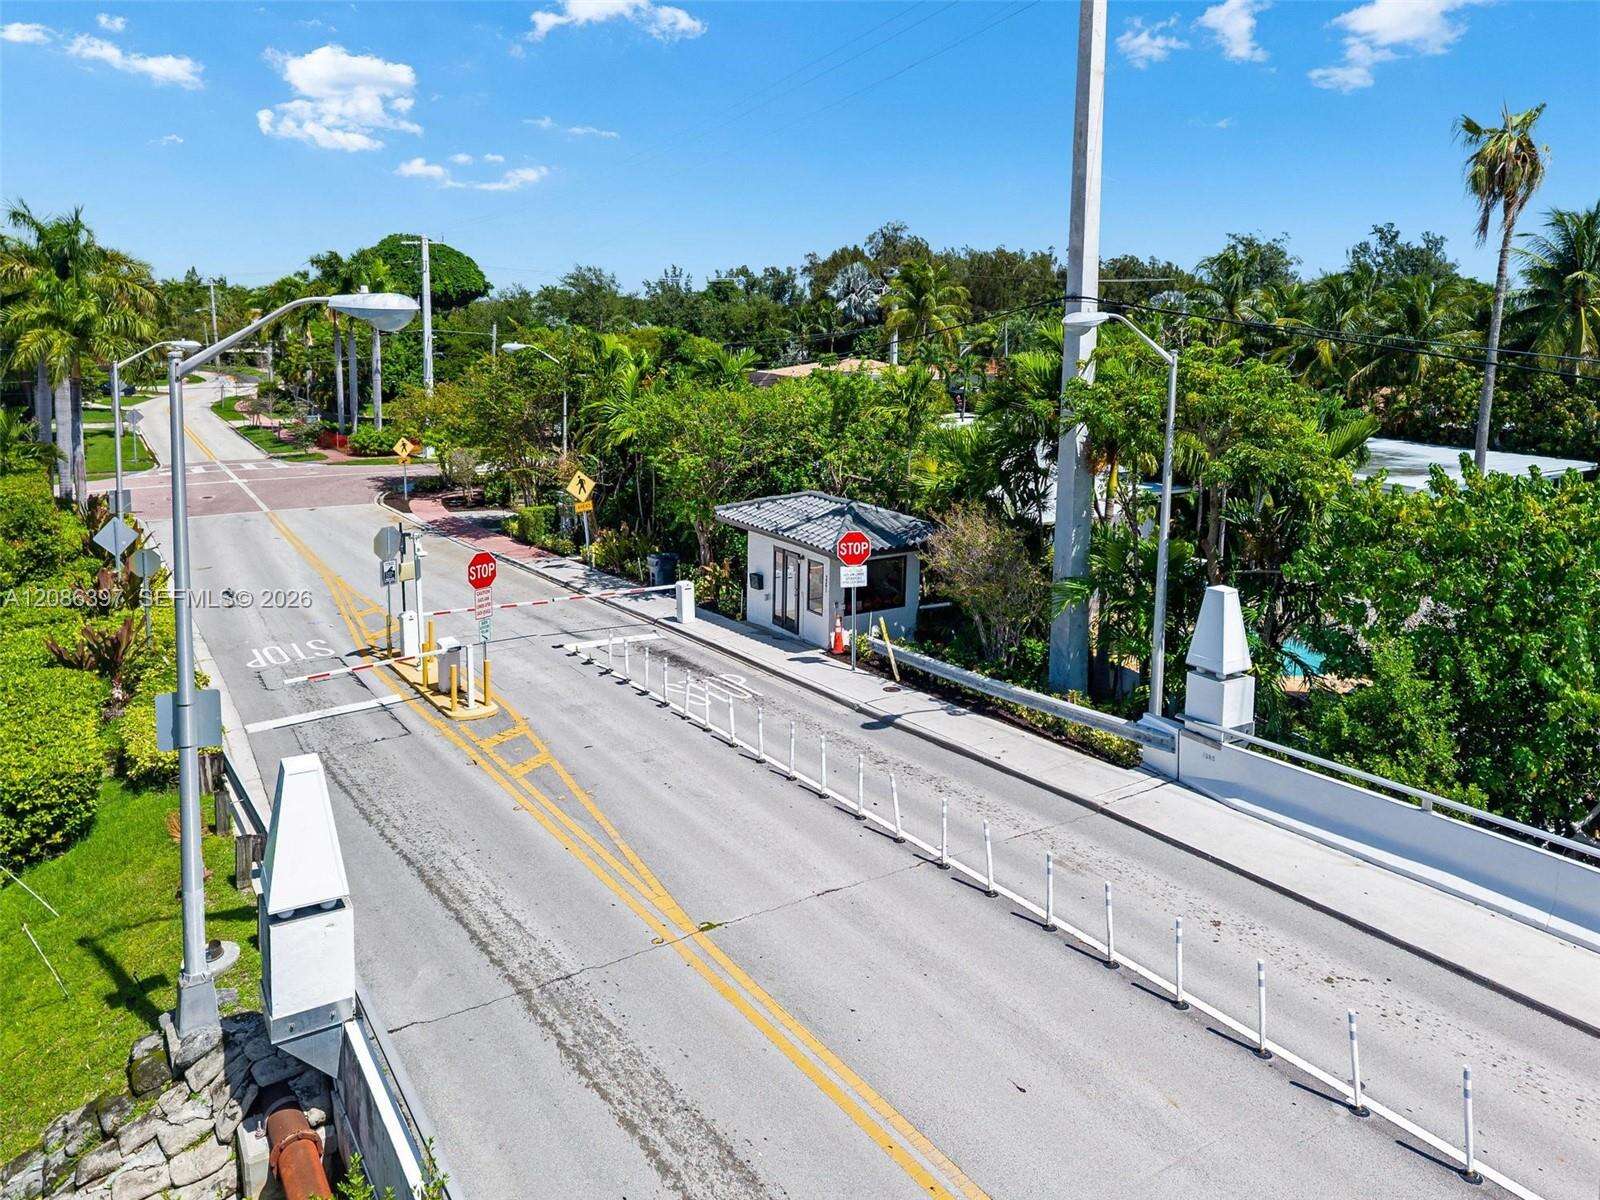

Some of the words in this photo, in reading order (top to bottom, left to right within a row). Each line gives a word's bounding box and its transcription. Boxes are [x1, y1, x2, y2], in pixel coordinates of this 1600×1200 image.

[840, 541, 869, 556] STOP
[469, 562, 495, 580] STOP
[246, 639, 336, 668] STOP
[664, 673, 765, 706] STOP
